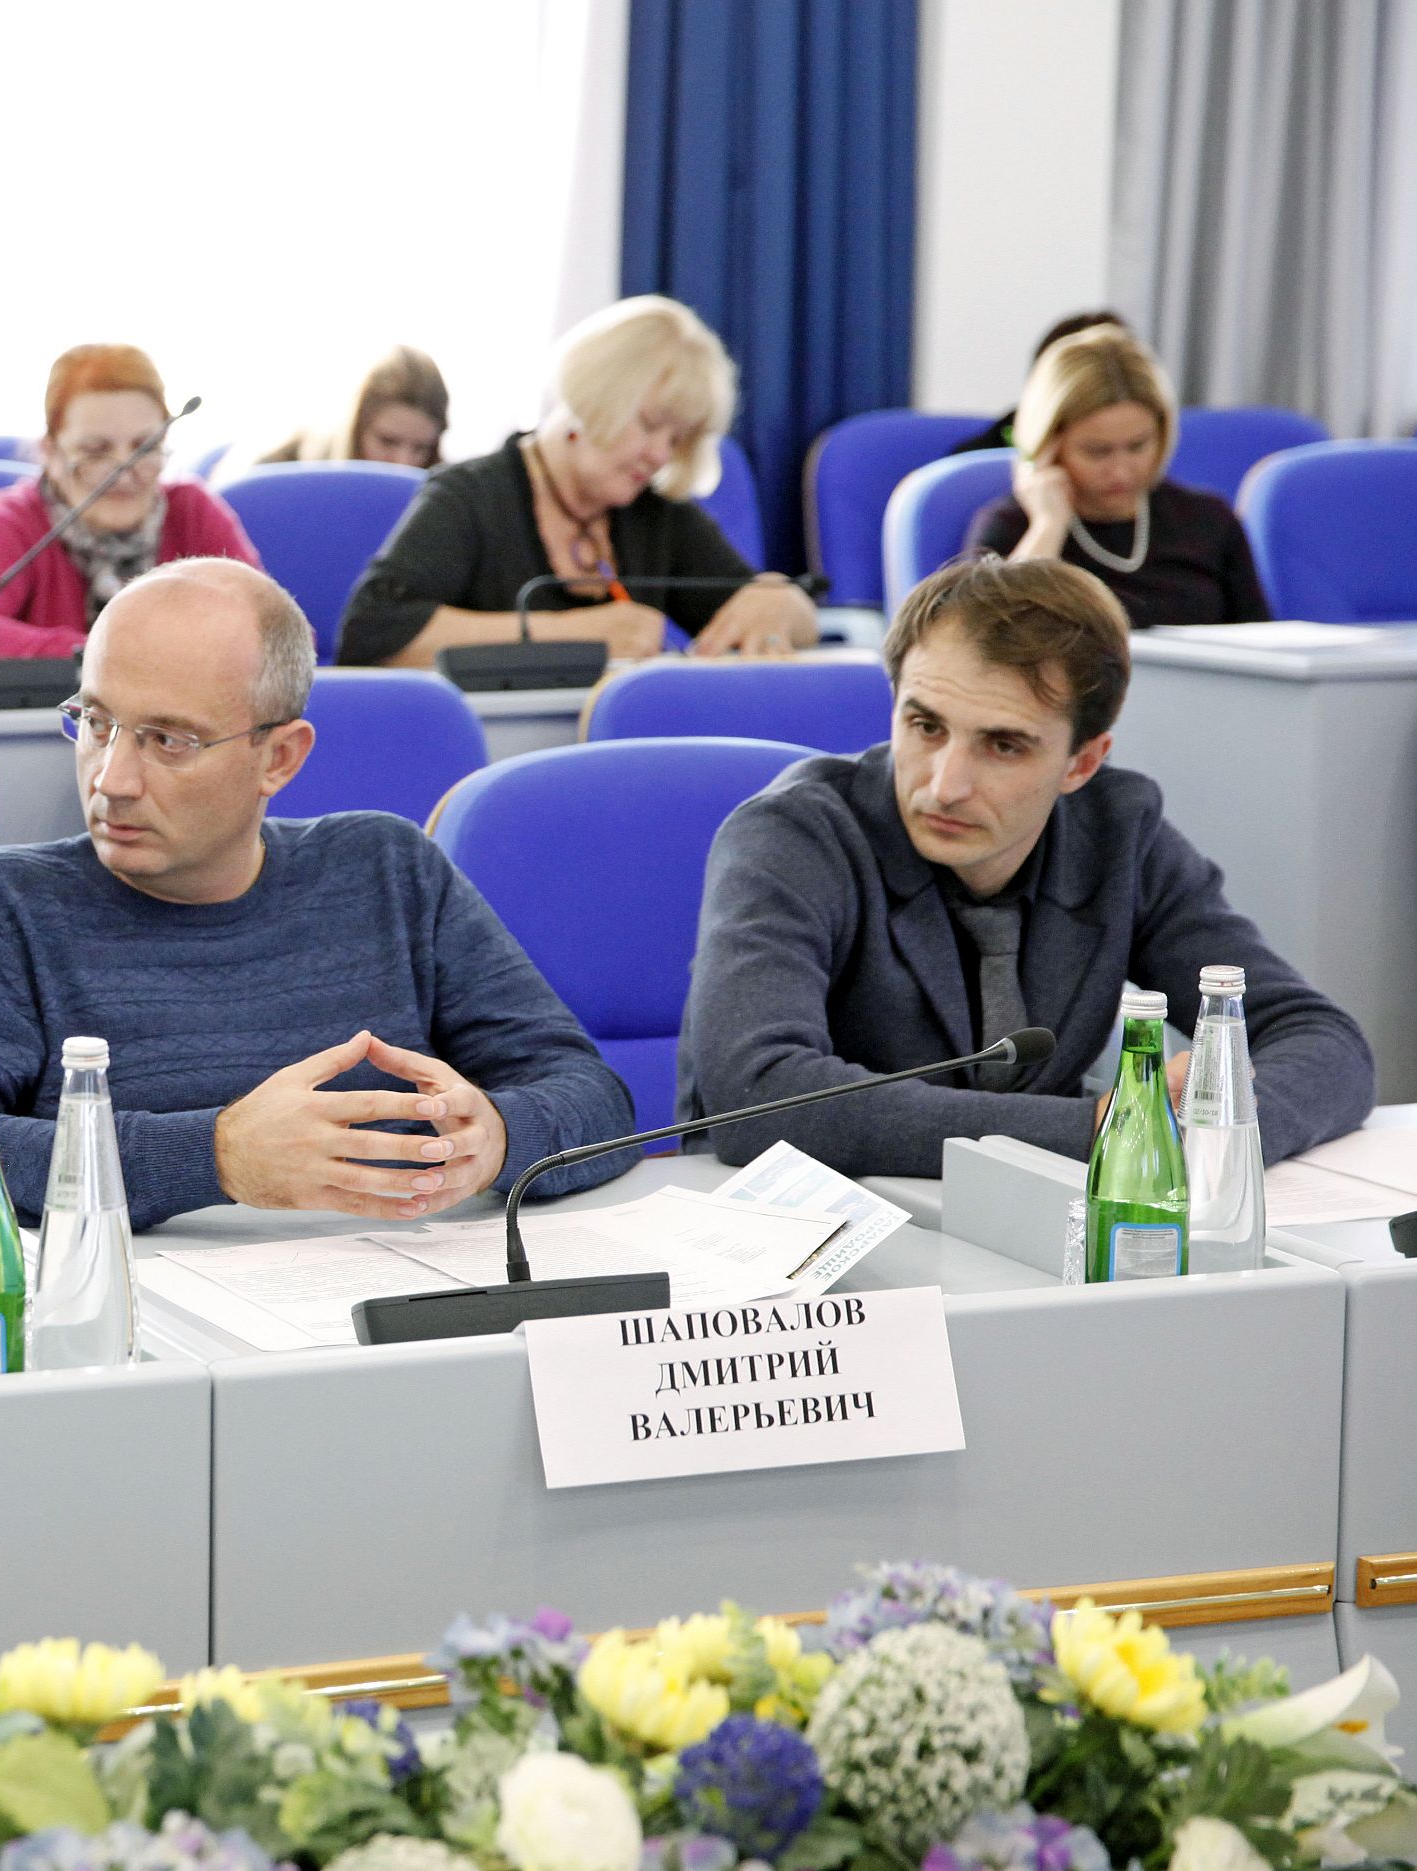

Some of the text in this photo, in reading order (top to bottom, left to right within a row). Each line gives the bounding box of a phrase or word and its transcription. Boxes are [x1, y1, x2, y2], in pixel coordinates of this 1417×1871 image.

[619, 1298, 866, 1347] ШАПОВАЛОВ
[654, 1341, 841, 1398] ДМИТРИЙ
[629, 1391, 877, 1441] ВАЛЕРЬЕВИЧ
